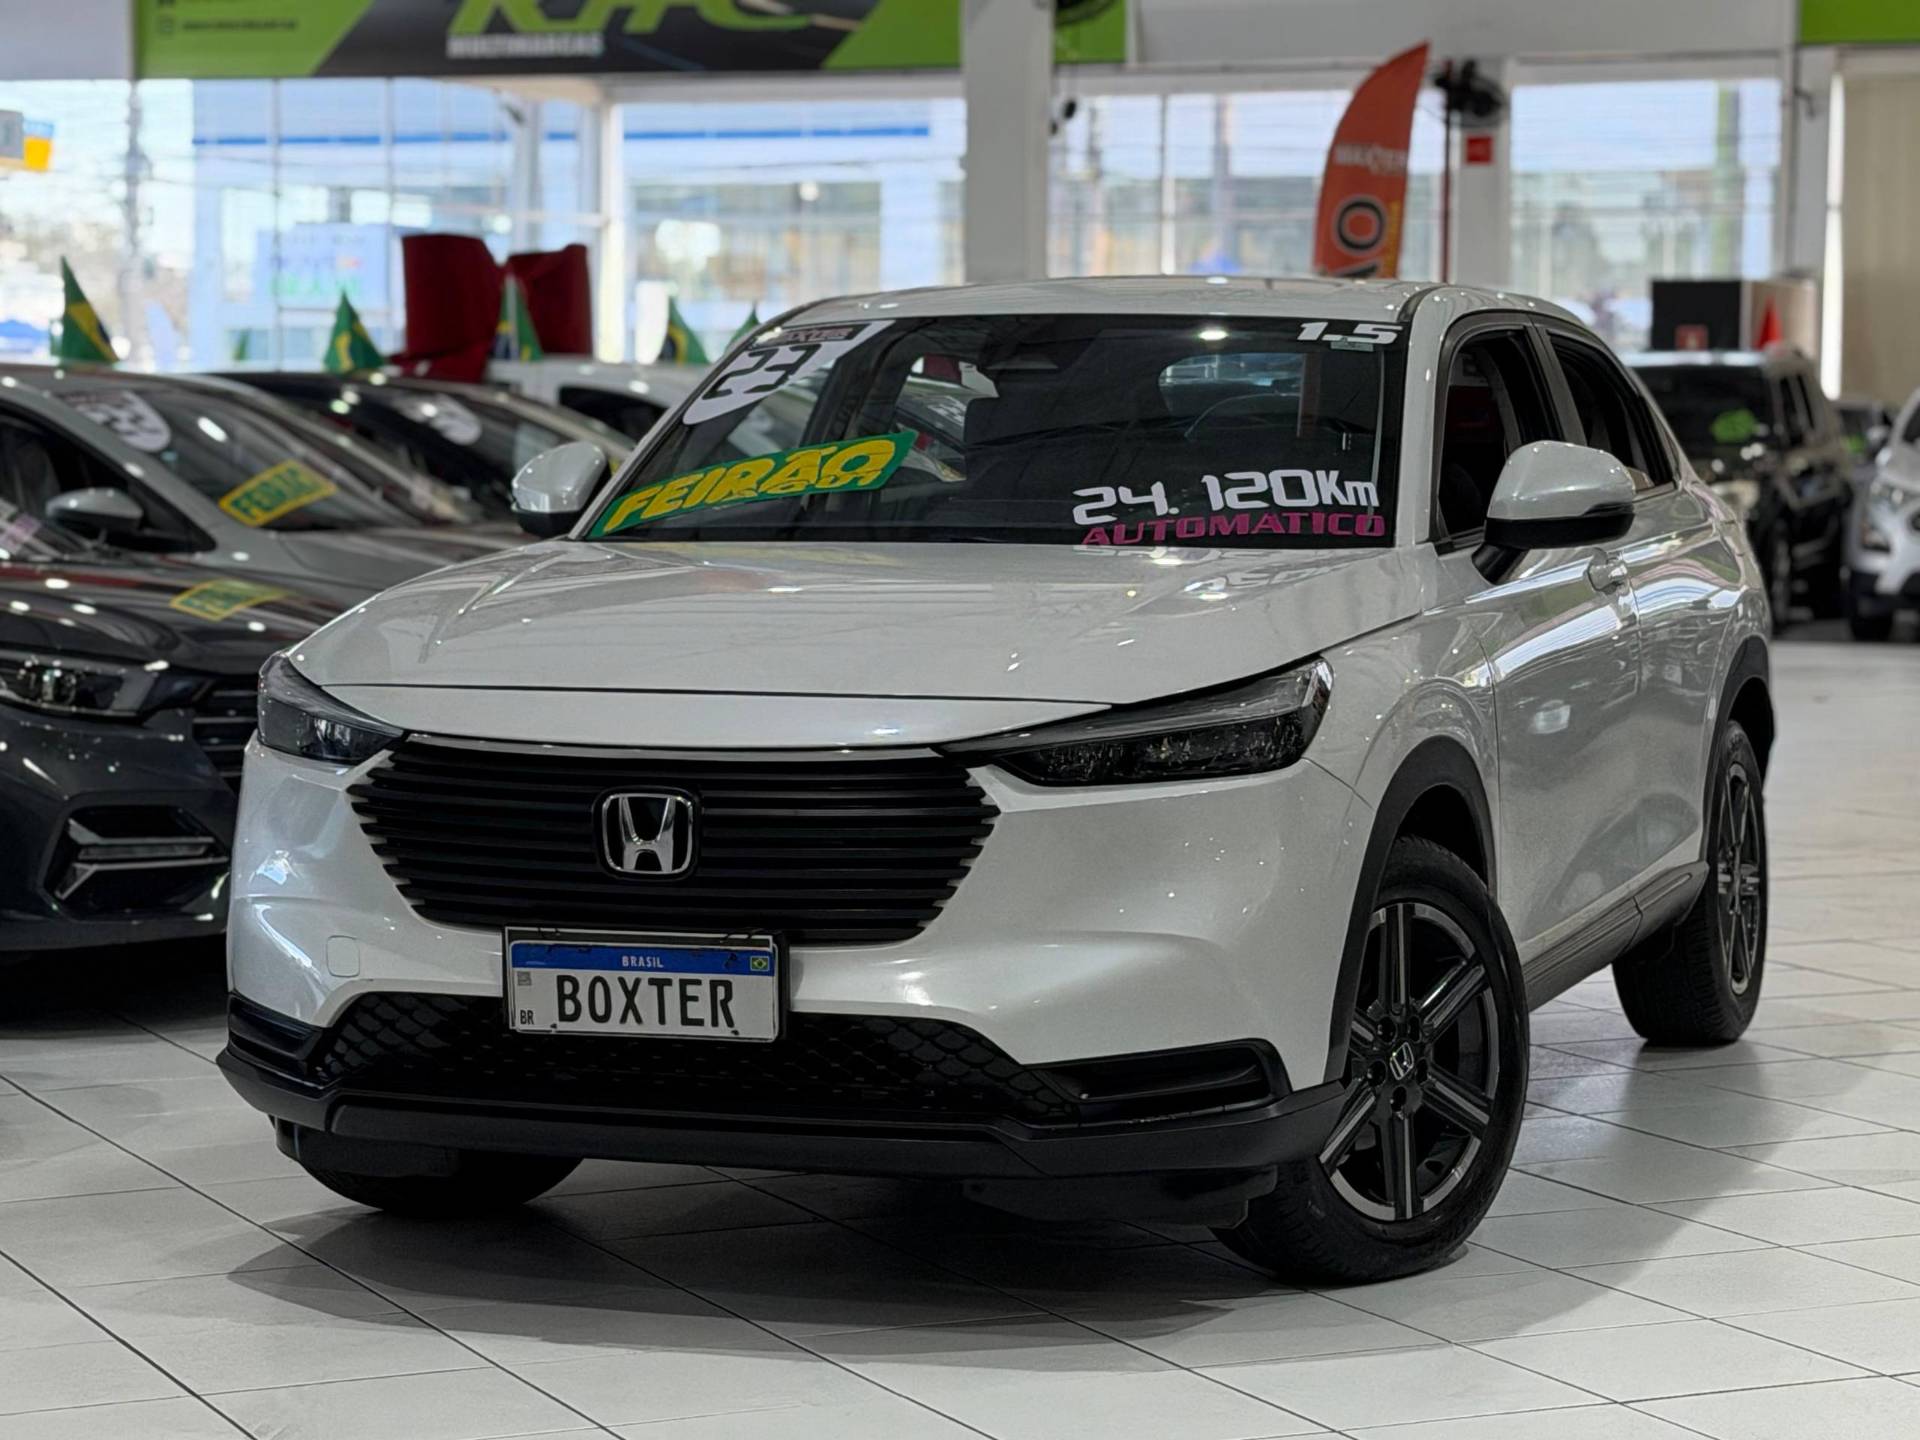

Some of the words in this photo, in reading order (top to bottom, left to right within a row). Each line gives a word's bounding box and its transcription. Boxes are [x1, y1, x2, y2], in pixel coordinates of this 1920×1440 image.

[702, 343, 822, 400] 23
[1201, 468, 1380, 512] 120Km
[1081, 511, 1386, 545] AUTOMATICO
[621, 955, 664, 968] BRASIL
[519, 1009, 535, 1025] BR
[556, 974, 735, 1028] BOXTER
